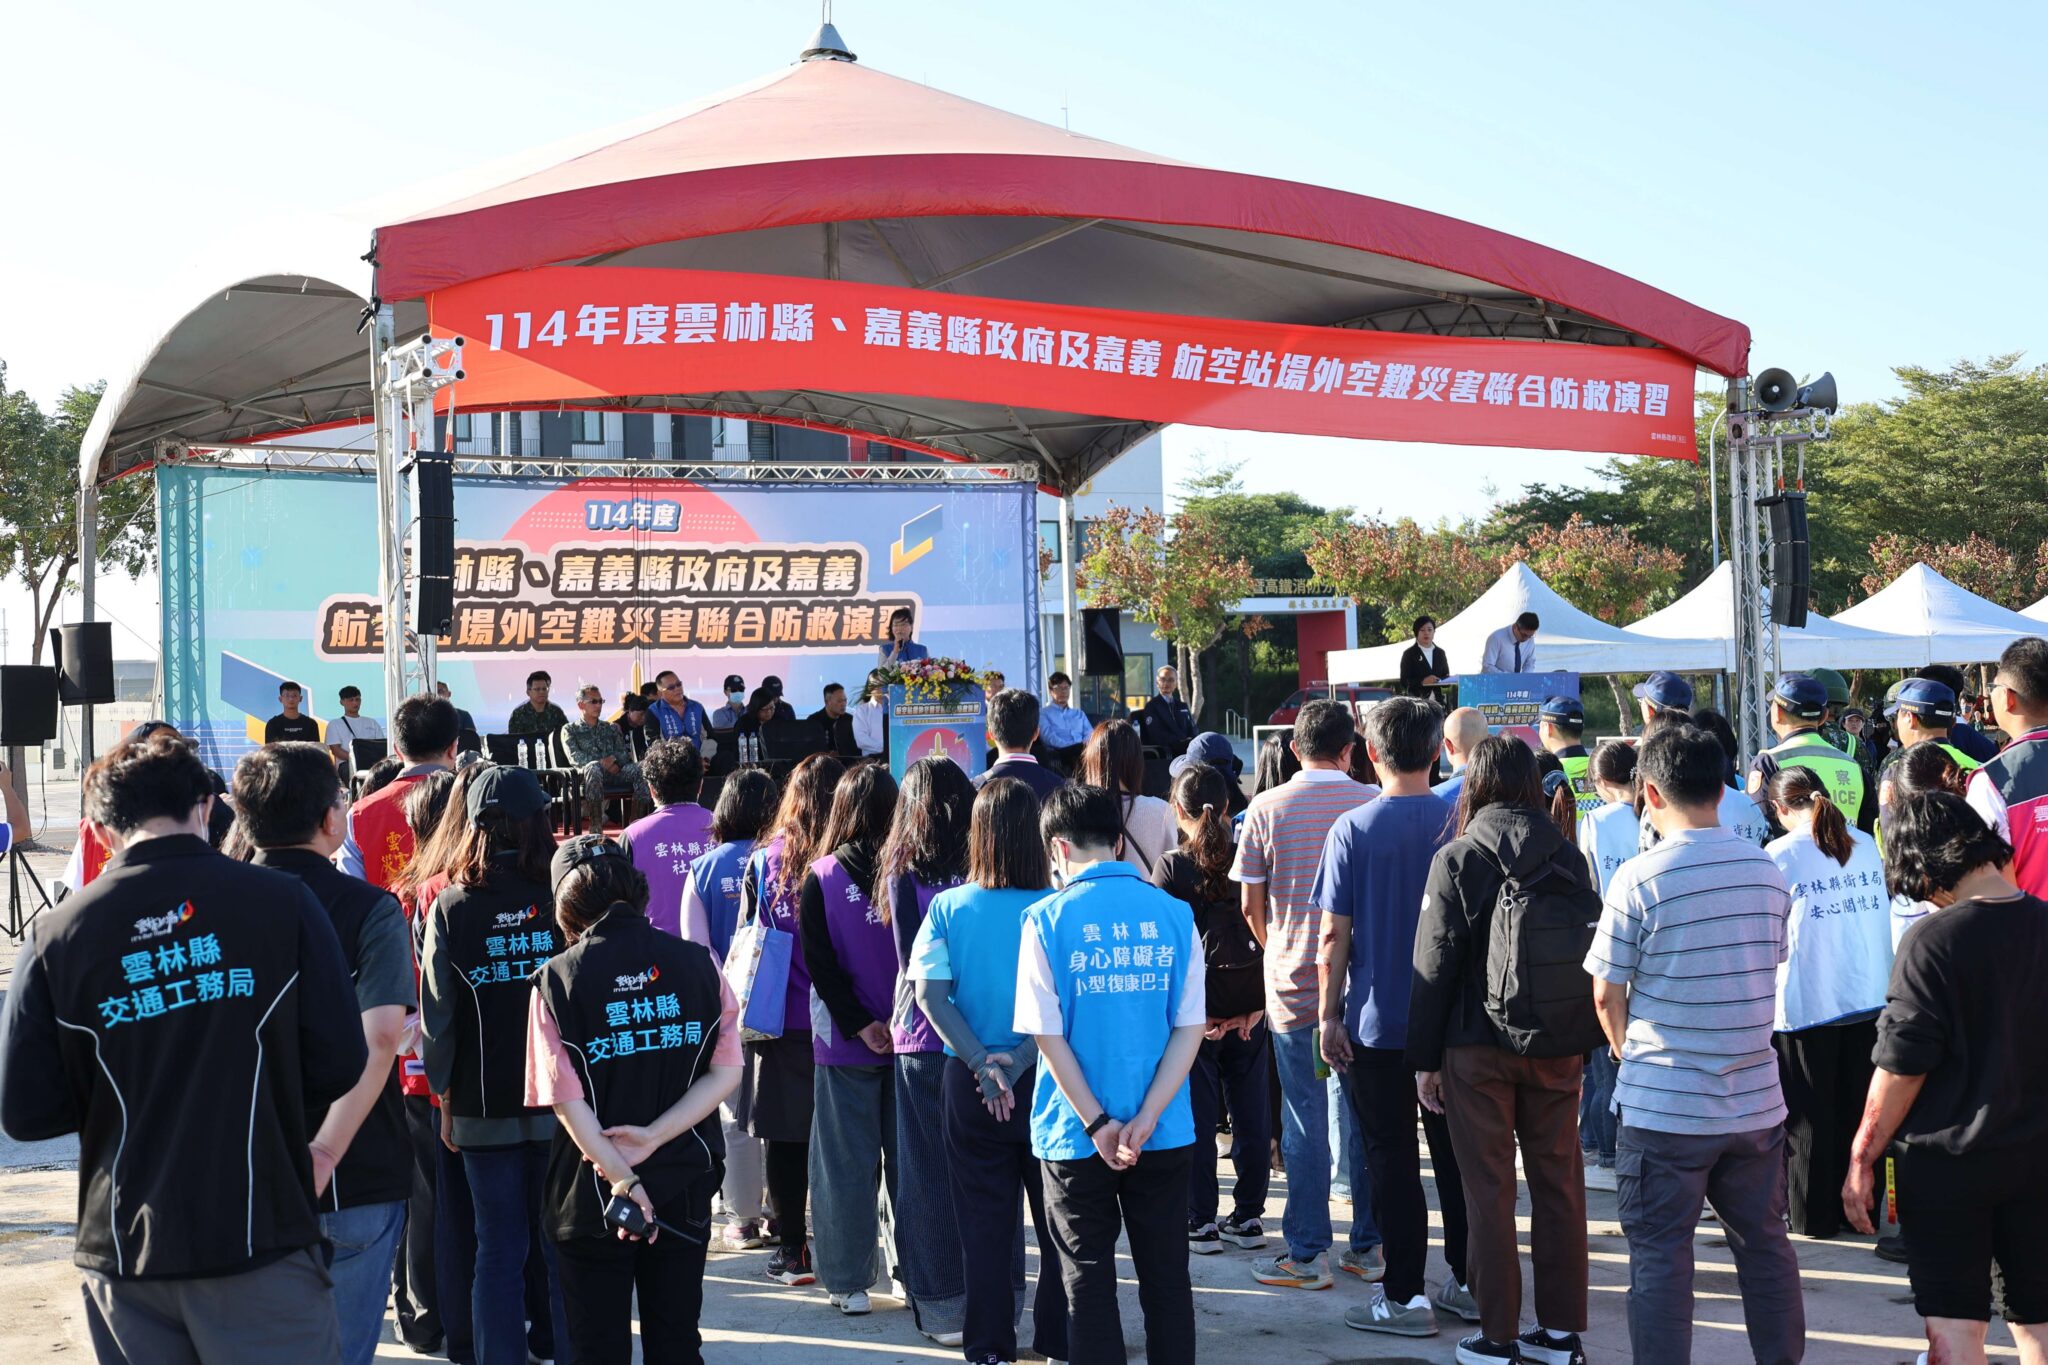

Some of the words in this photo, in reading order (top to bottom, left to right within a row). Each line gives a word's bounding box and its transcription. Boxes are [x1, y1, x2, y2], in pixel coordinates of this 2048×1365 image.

[587, 503, 680, 528] 114年度
[404, 554, 858, 592] 林縣、嘉義縣政府及嘉義
[386, 831, 401, 851] 雲
[655, 841, 718, 858] 雲林縣政
[672, 859, 689, 875] 社
[845, 884, 862, 903] 雲
[1796, 871, 1882, 898] 雲林縣衛生局
[775, 901, 792, 918] 社
[485, 930, 553, 957] 雲林縣
[1083, 921, 1160, 943] 雲林縣
[121, 933, 222, 984] 雲林縣
[1069, 945, 1176, 974] 身心障礙者
[1075, 973, 1171, 997] 小型復康巴士
[98, 968, 255, 1029] 交通工務局
[605, 992, 681, 1027] 雲林縣
[586, 1021, 702, 1064] 交通工務局
